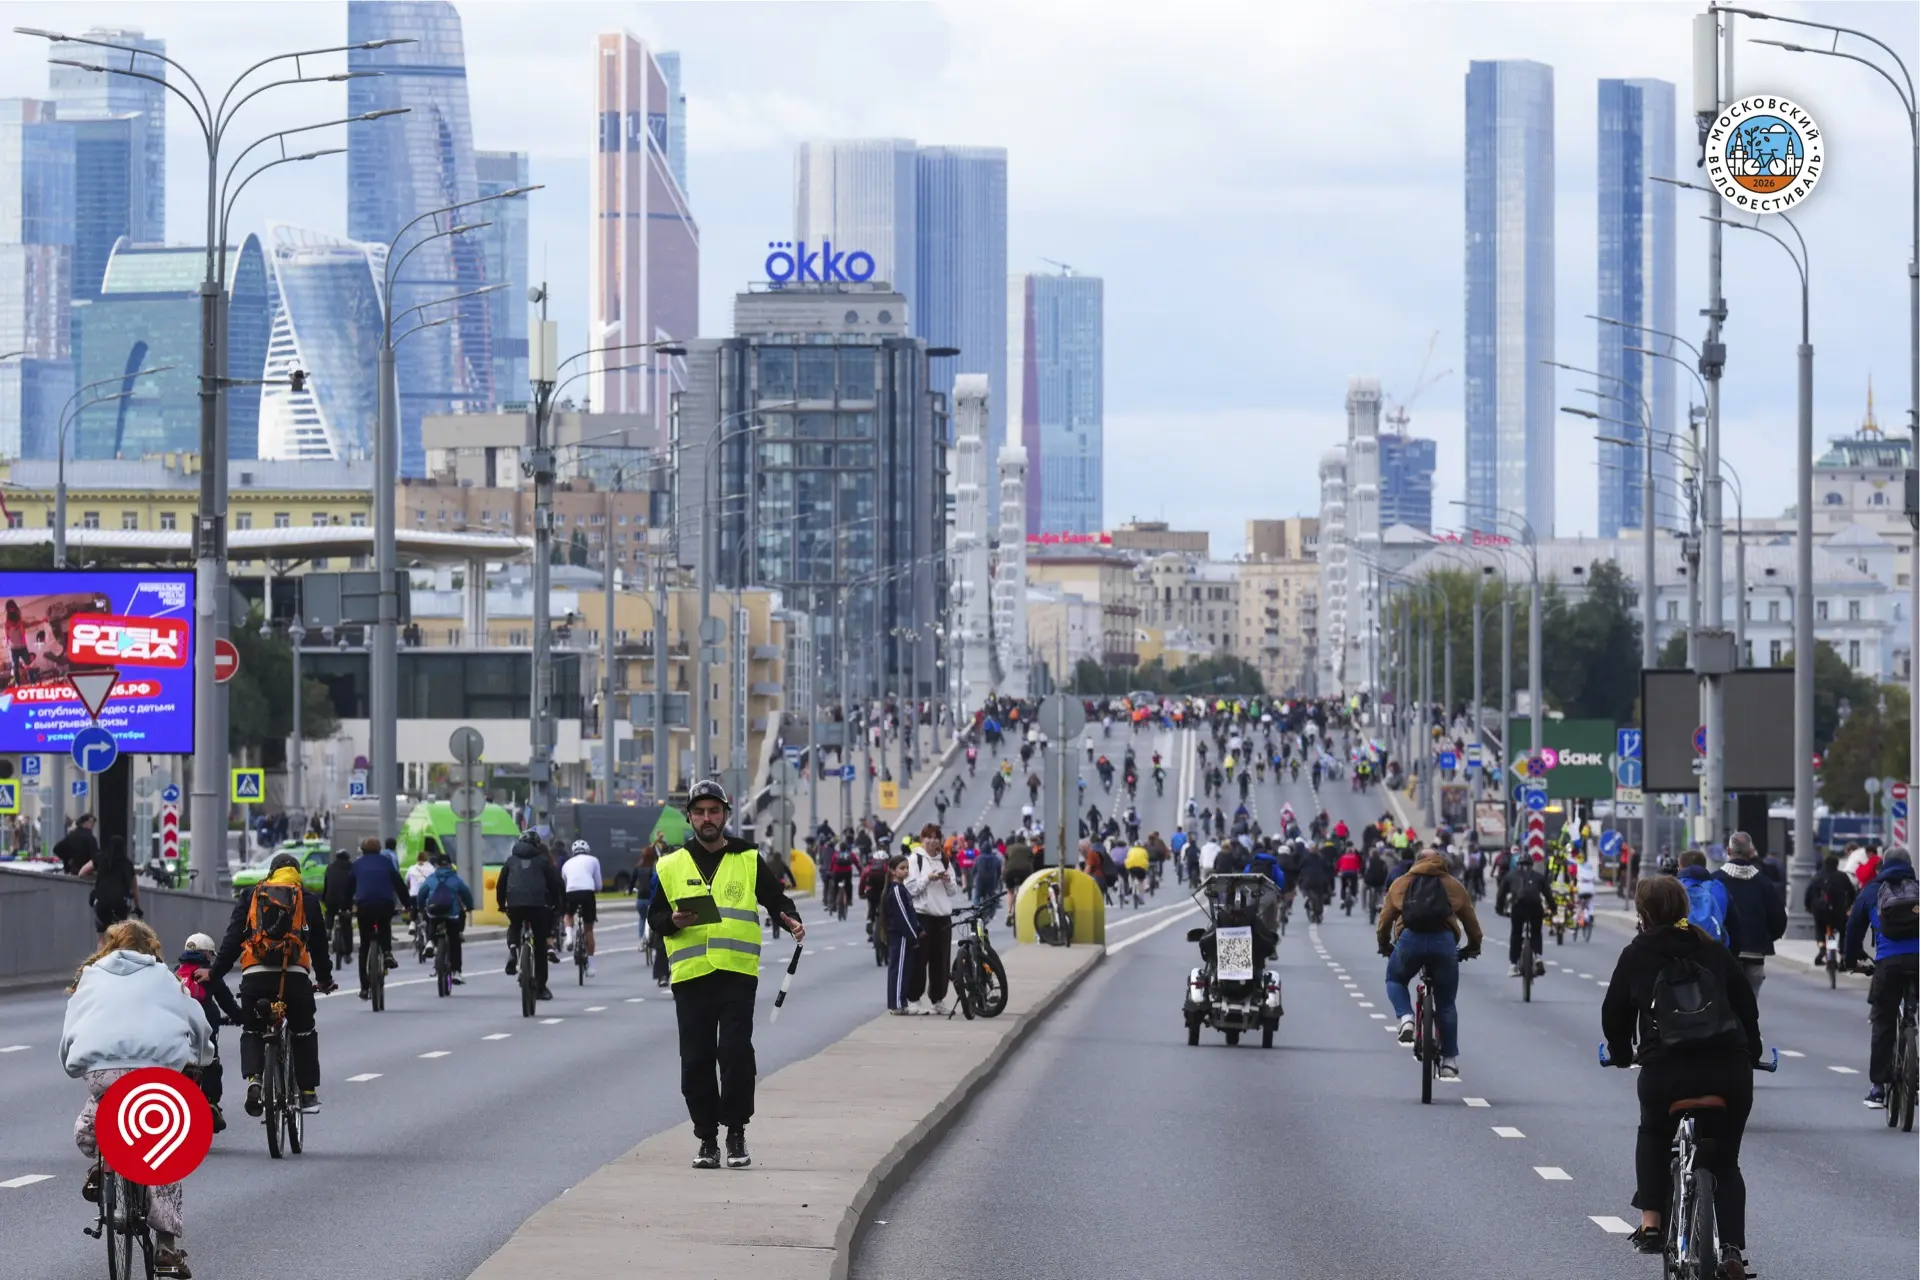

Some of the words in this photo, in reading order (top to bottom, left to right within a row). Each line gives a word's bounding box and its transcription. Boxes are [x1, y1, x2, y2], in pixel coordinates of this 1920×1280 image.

[73, 624, 177, 646] ОТЕЦ
[72, 639, 177, 659] ГОДА
[17, 683, 150, 700] ОТЕЦГО26.РФ
[38, 706, 88, 718] опублику
[101, 705, 127, 715] идео
[129, 705, 135, 713] с
[137, 703, 175, 714] детьми
[34, 718, 92, 730] выигрывай
[1559, 748, 1602, 766] банк
